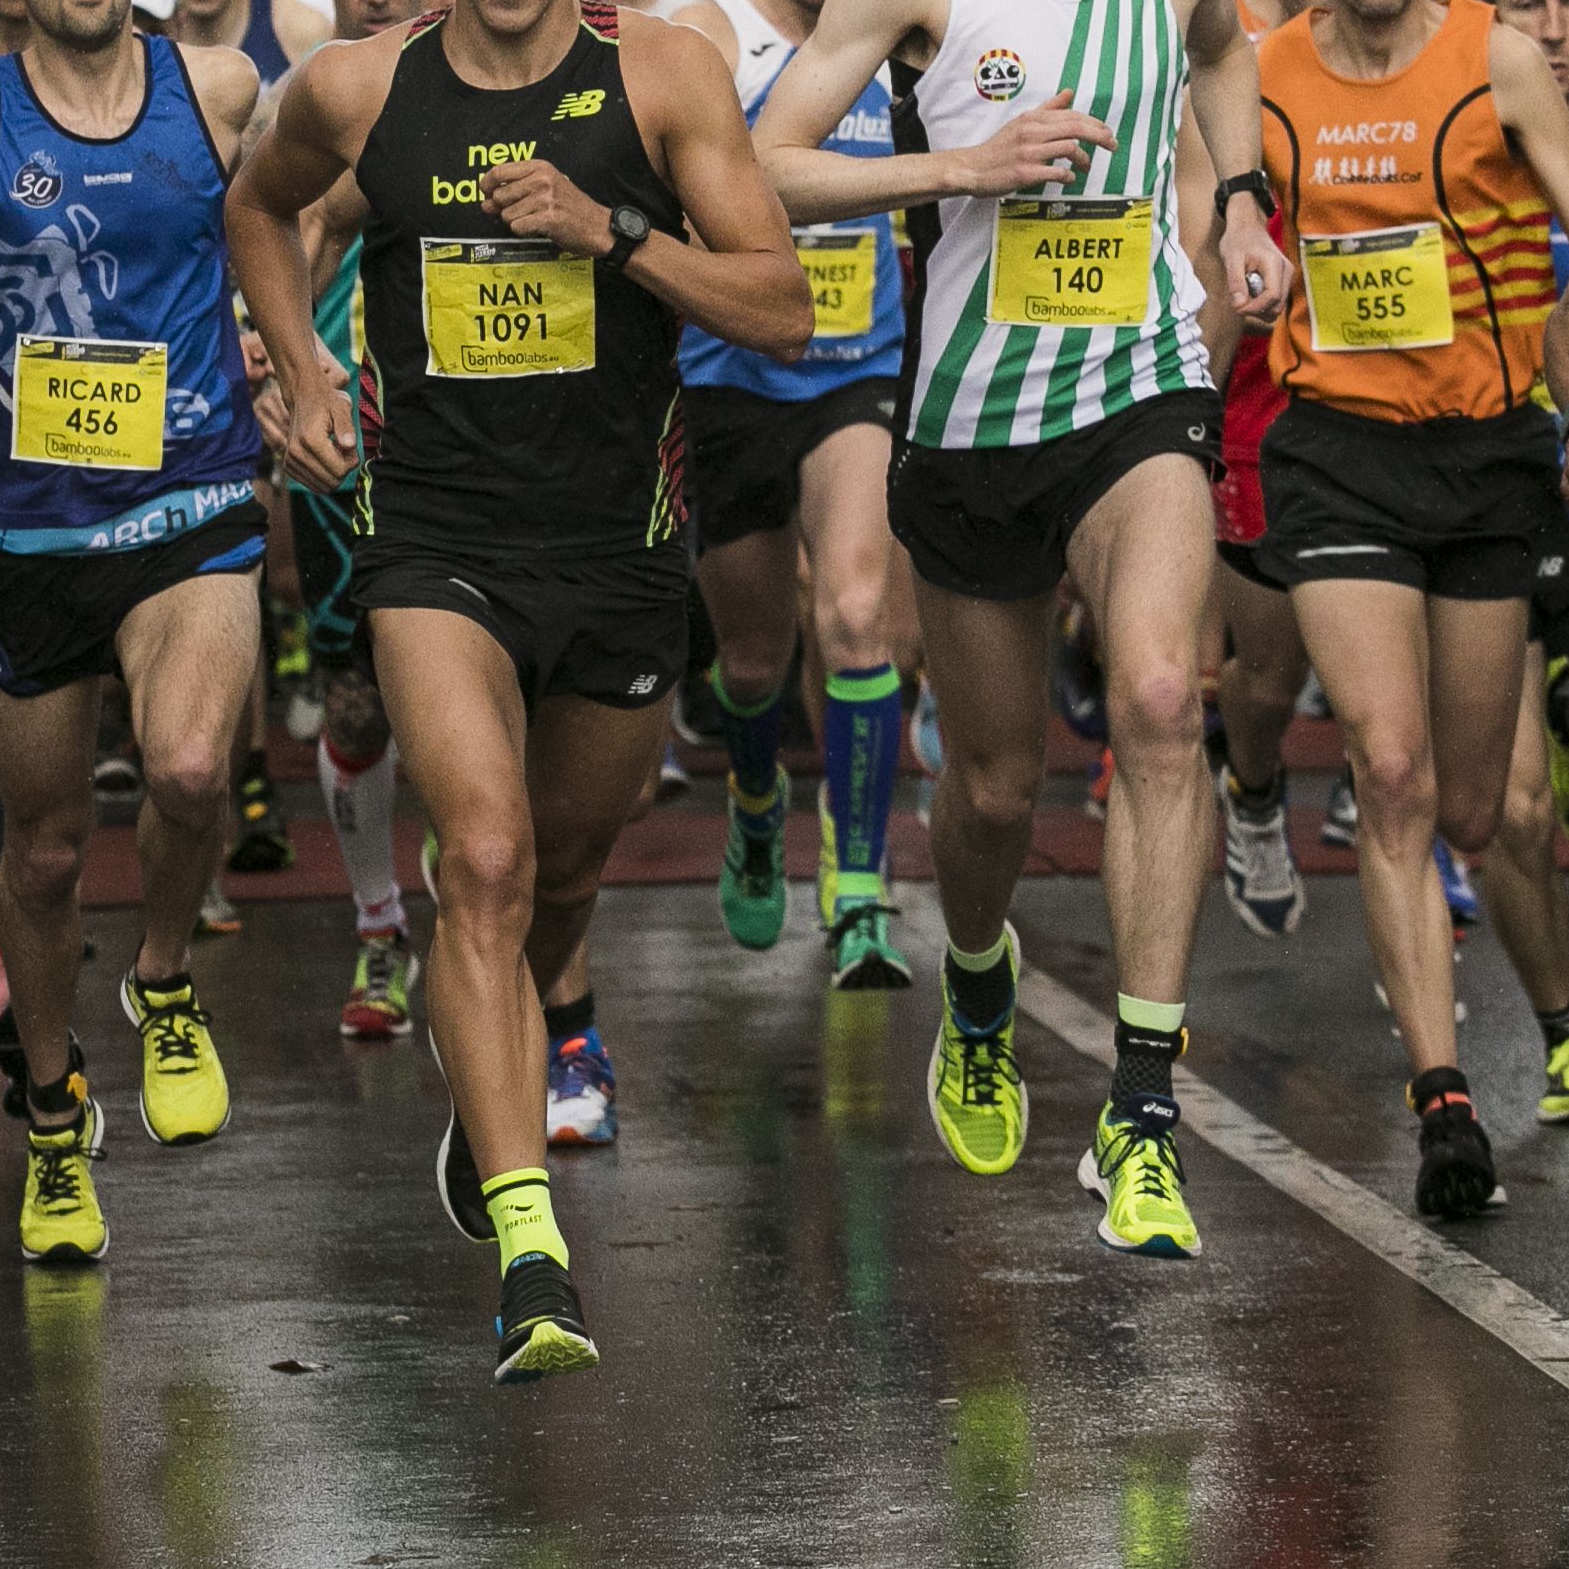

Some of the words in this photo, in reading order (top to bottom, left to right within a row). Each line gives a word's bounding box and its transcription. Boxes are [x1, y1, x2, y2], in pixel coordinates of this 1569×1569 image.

[1316, 120, 1417, 146] MARC78
[467, 140, 537, 168] new
[1034, 238, 1125, 260] ALBERT
[1052, 266, 1104, 293] 140
[1340, 266, 1414, 291] MARC
[479, 281, 543, 306] NAN
[1356, 294, 1406, 320] 555
[474, 313, 548, 342] 1091
[47, 377, 142, 404] RICARD
[65, 408, 118, 436] 456
